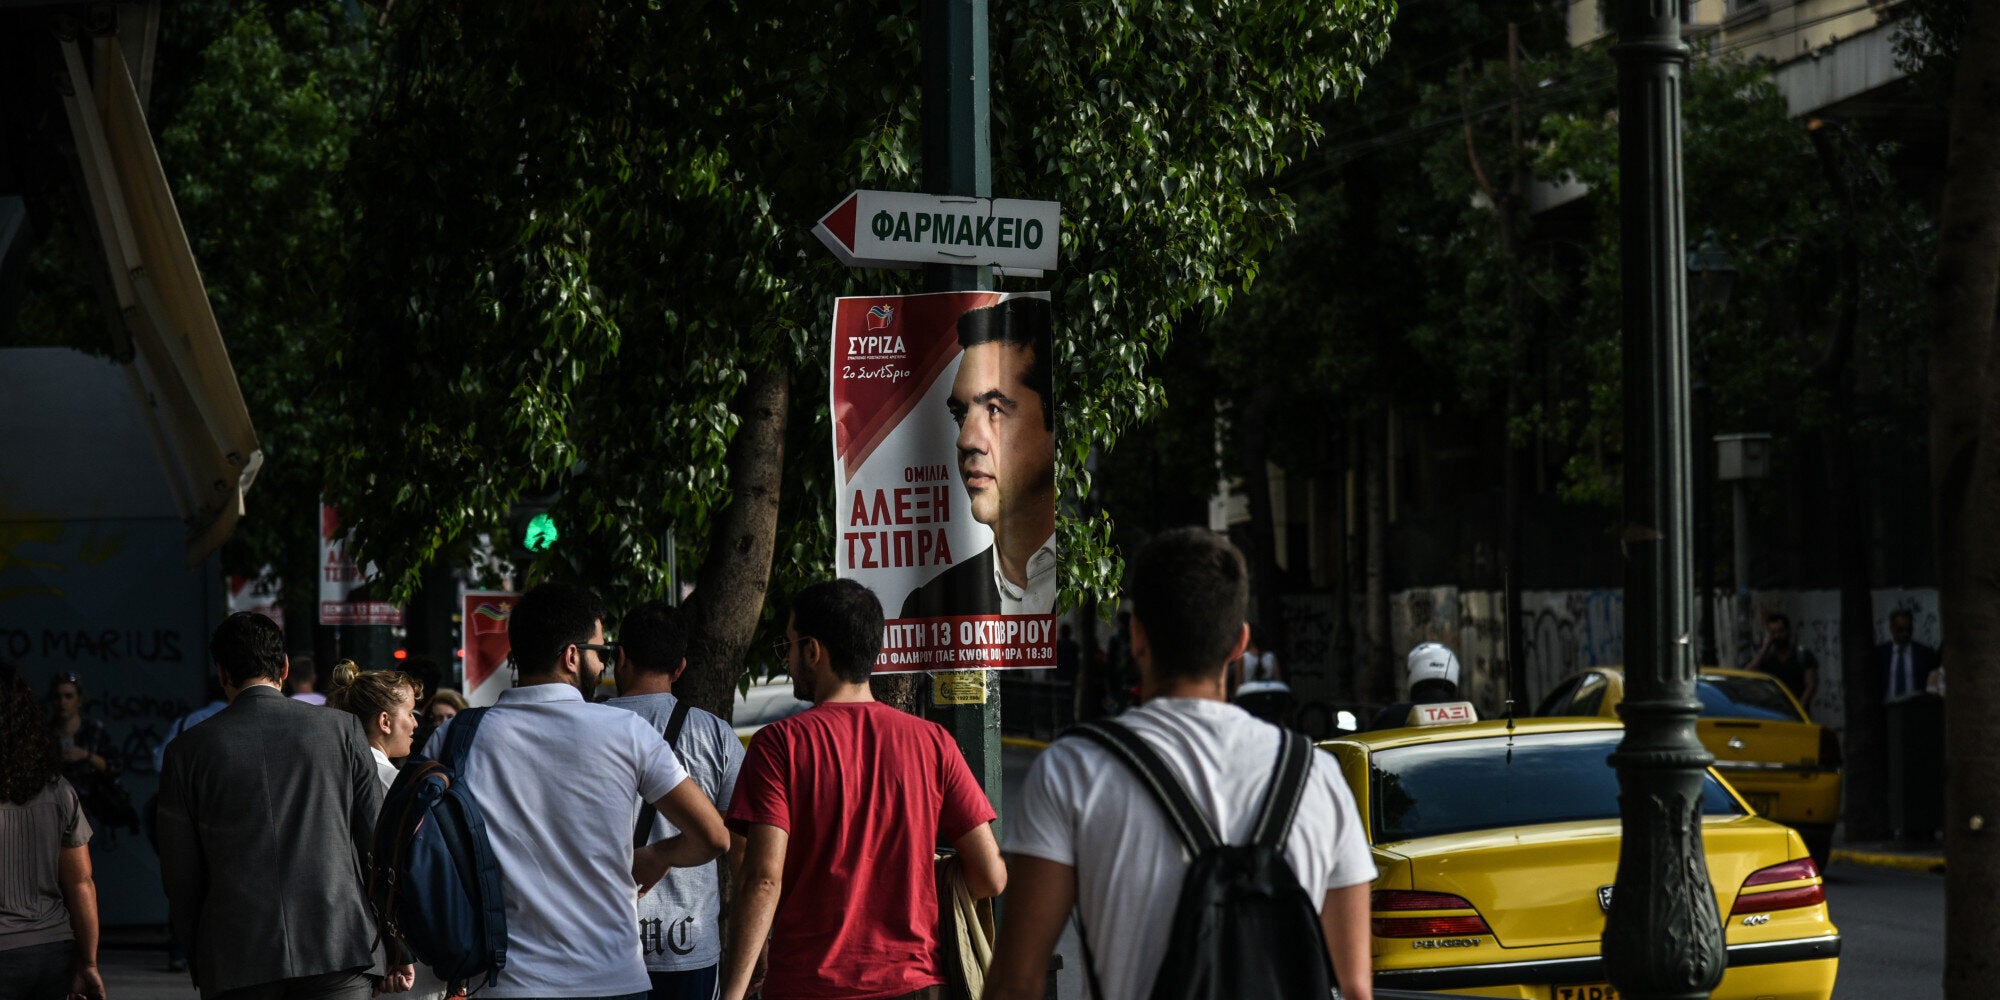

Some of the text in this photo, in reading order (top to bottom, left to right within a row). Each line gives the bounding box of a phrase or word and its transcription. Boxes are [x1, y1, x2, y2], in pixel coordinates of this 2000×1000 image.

[871, 209, 1044, 250] ΦΑΡΜΑΚΕΙΟ
[848, 335, 906, 355] ΣΥΡΙΖΑ
[904, 464, 949, 483] ΟΜΙΛΙΑ
[850, 485, 950, 527] ΑΛΕΞΗ
[844, 528, 953, 570] ΤΣΙΠΡΑ
[931, 622, 952, 646] 13
[960, 619, 1052, 646] ΟΚΤΩΒΡΙΟΥ
[41, 629, 183, 663] MARIUS
[890, 650, 933, 664] ΦΑΛΗΡΟΥ
[1026, 646, 1053, 659] 18:30
[1425, 706, 1470, 721] ΤΑΞΙ
[1413, 937, 1482, 949] PEUGEOT
